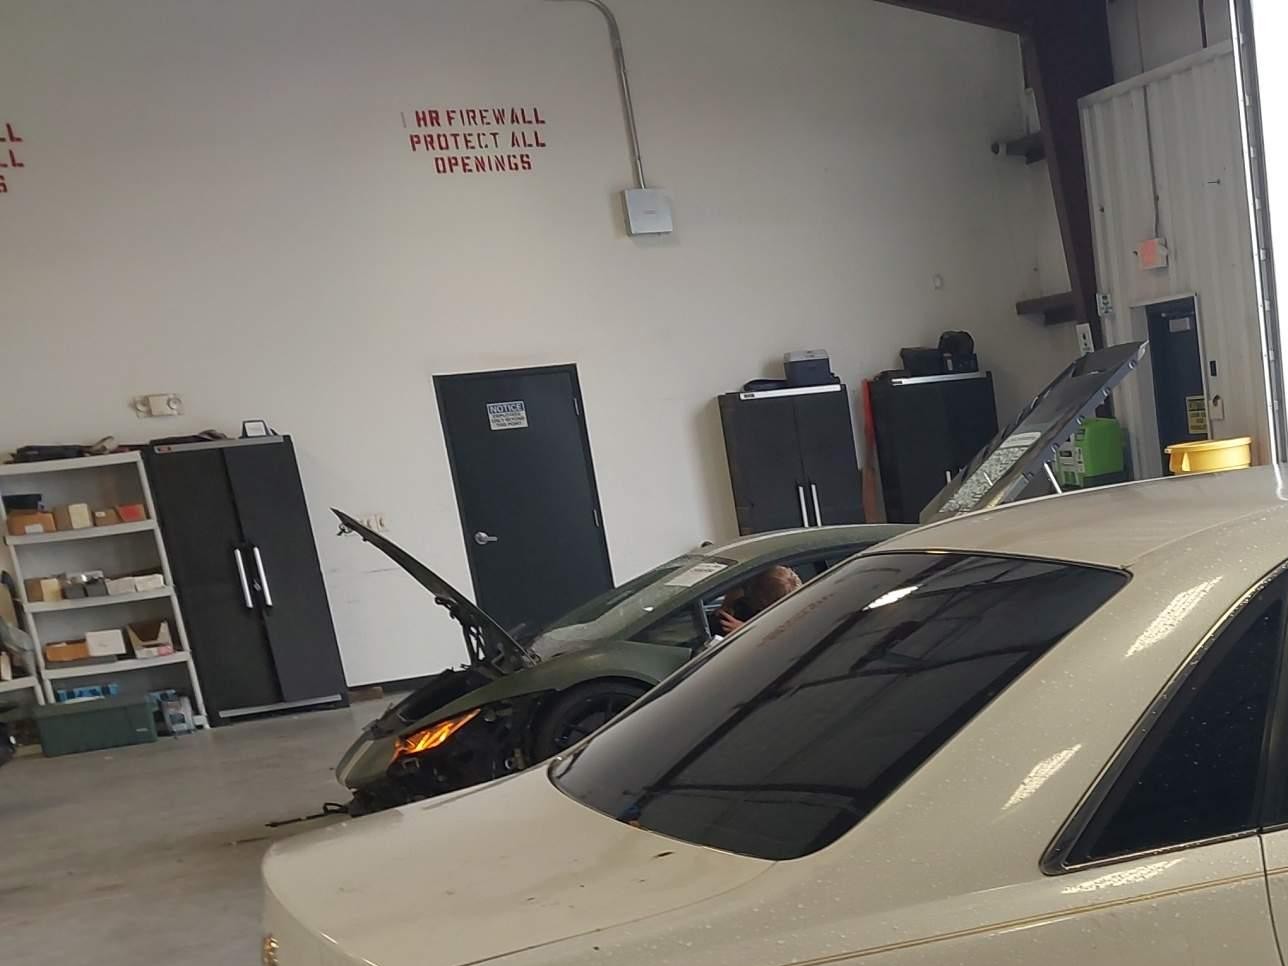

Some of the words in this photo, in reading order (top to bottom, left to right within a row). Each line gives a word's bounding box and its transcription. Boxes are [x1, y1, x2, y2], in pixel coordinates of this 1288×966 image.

[415, 109, 441, 128] HR
[446, 107, 546, 127] FIREWALL
[409, 132, 500, 152] PROTECT
[511, 130, 546, 148] ALL
[434, 154, 532, 174] OPENINGS
[490, 403, 522, 414] NOTICE
